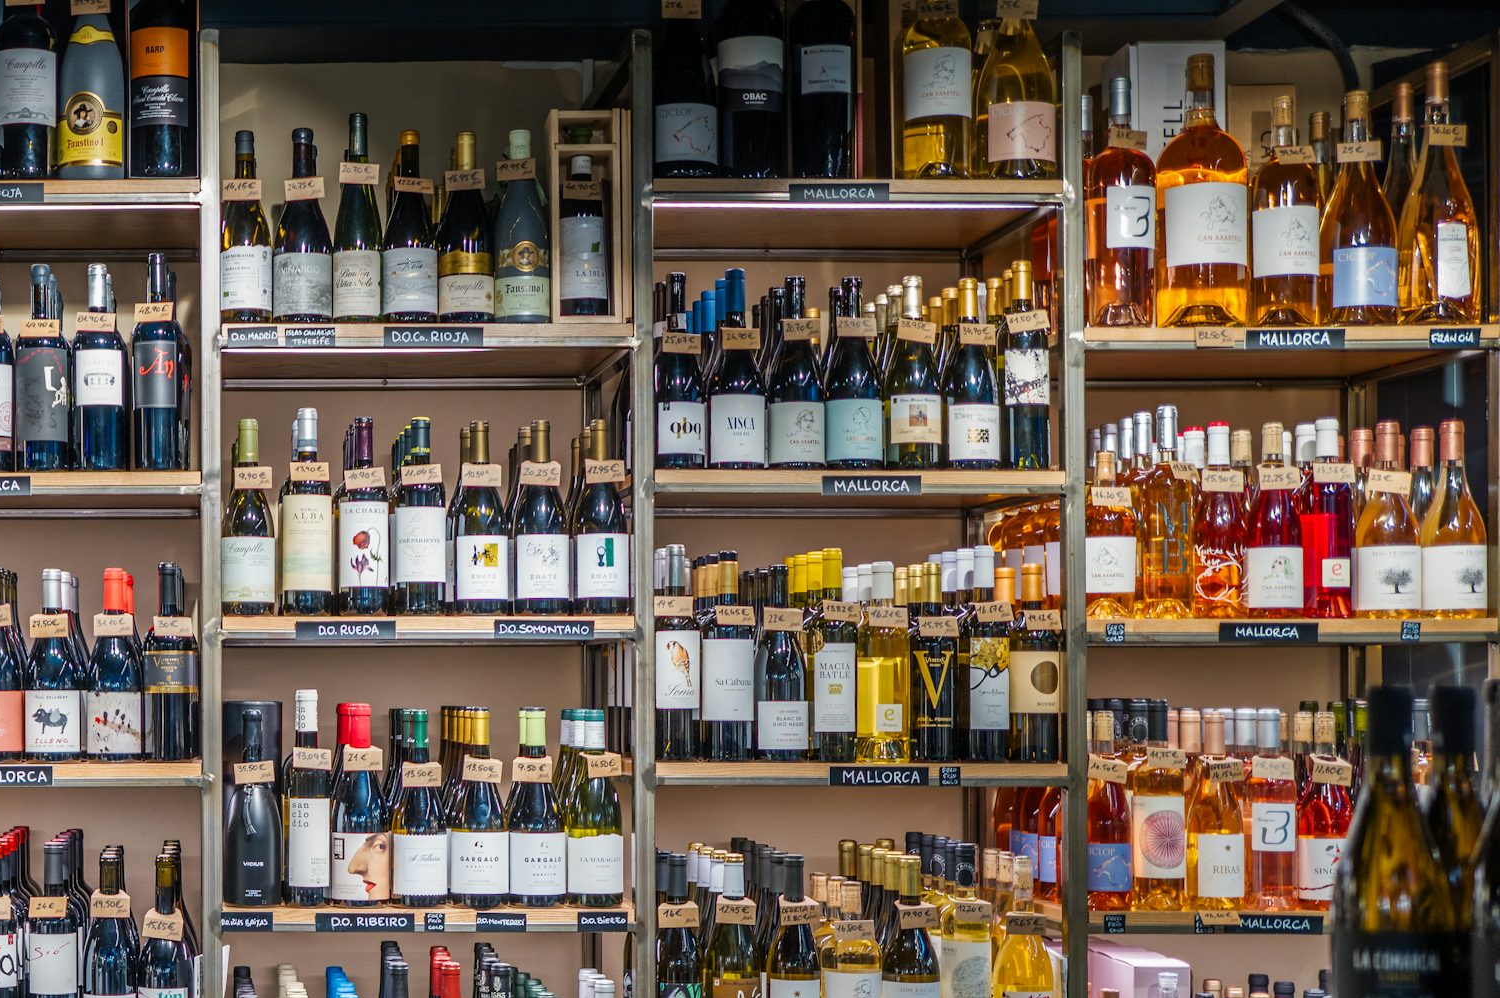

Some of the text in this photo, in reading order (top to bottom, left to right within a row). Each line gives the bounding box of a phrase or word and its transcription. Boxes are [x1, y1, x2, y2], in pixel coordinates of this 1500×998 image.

[743, 93, 767, 101] OBAC
[804, 188, 875, 200] MALLORCA
[430, 331, 469, 343] RIOJA
[1259, 332, 1330, 346] MALLORCA
[727, 416, 755, 430] XISCA
[835, 479, 910, 492] MALLORCA
[292, 512, 324, 520] ALBA
[340, 625, 379, 636] RUEDA
[518, 624, 589, 635] SOMONTANO
[1235, 626, 1299, 638] MALLORCA
[820, 671, 850, 679] BATLE
[843, 771, 920, 784] MALLORCA
[1212, 865, 1240, 874] RIBAS
[331, 916, 407, 928] D.O. RIBEIRO
[1240, 918, 1310, 930] MALLORCA
